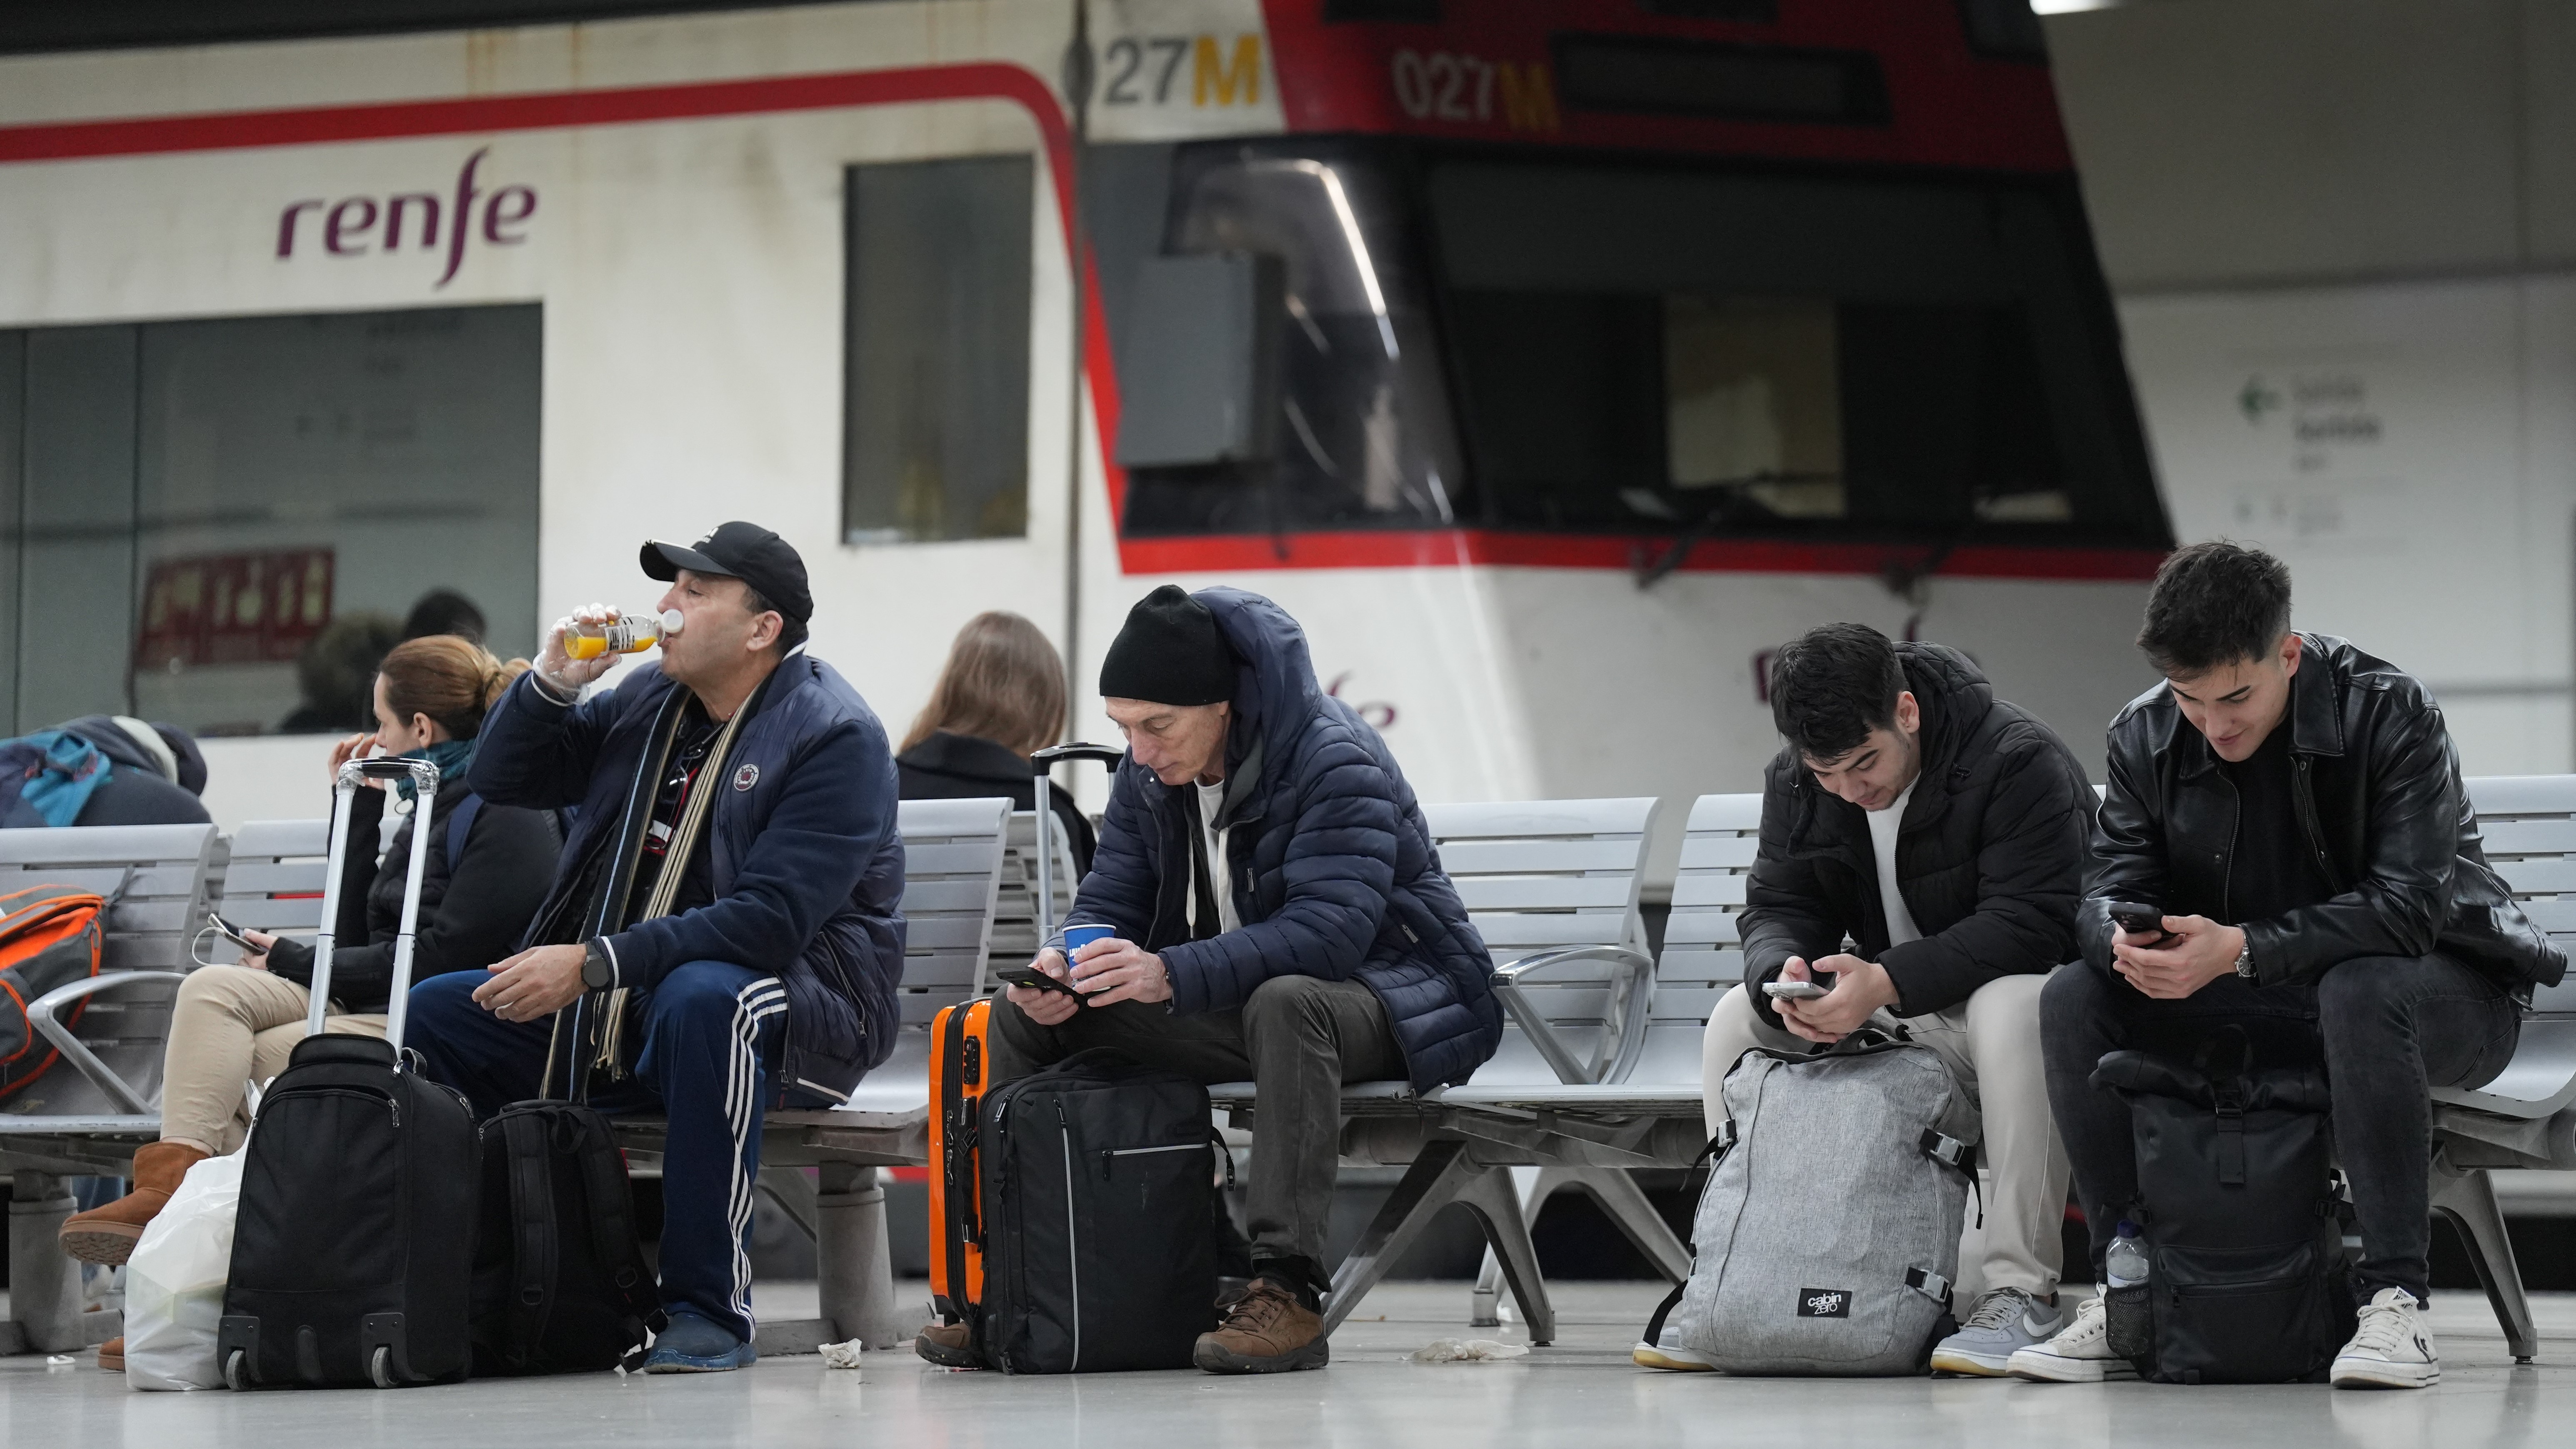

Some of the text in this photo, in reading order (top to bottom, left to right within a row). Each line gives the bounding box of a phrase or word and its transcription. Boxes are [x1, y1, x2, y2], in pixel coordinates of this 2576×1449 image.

[1392, 49, 1560, 132] 027M
[276, 145, 536, 290] renfe
[1808, 1292, 1841, 1306] cabin
[1814, 1303, 1838, 1314] zero
